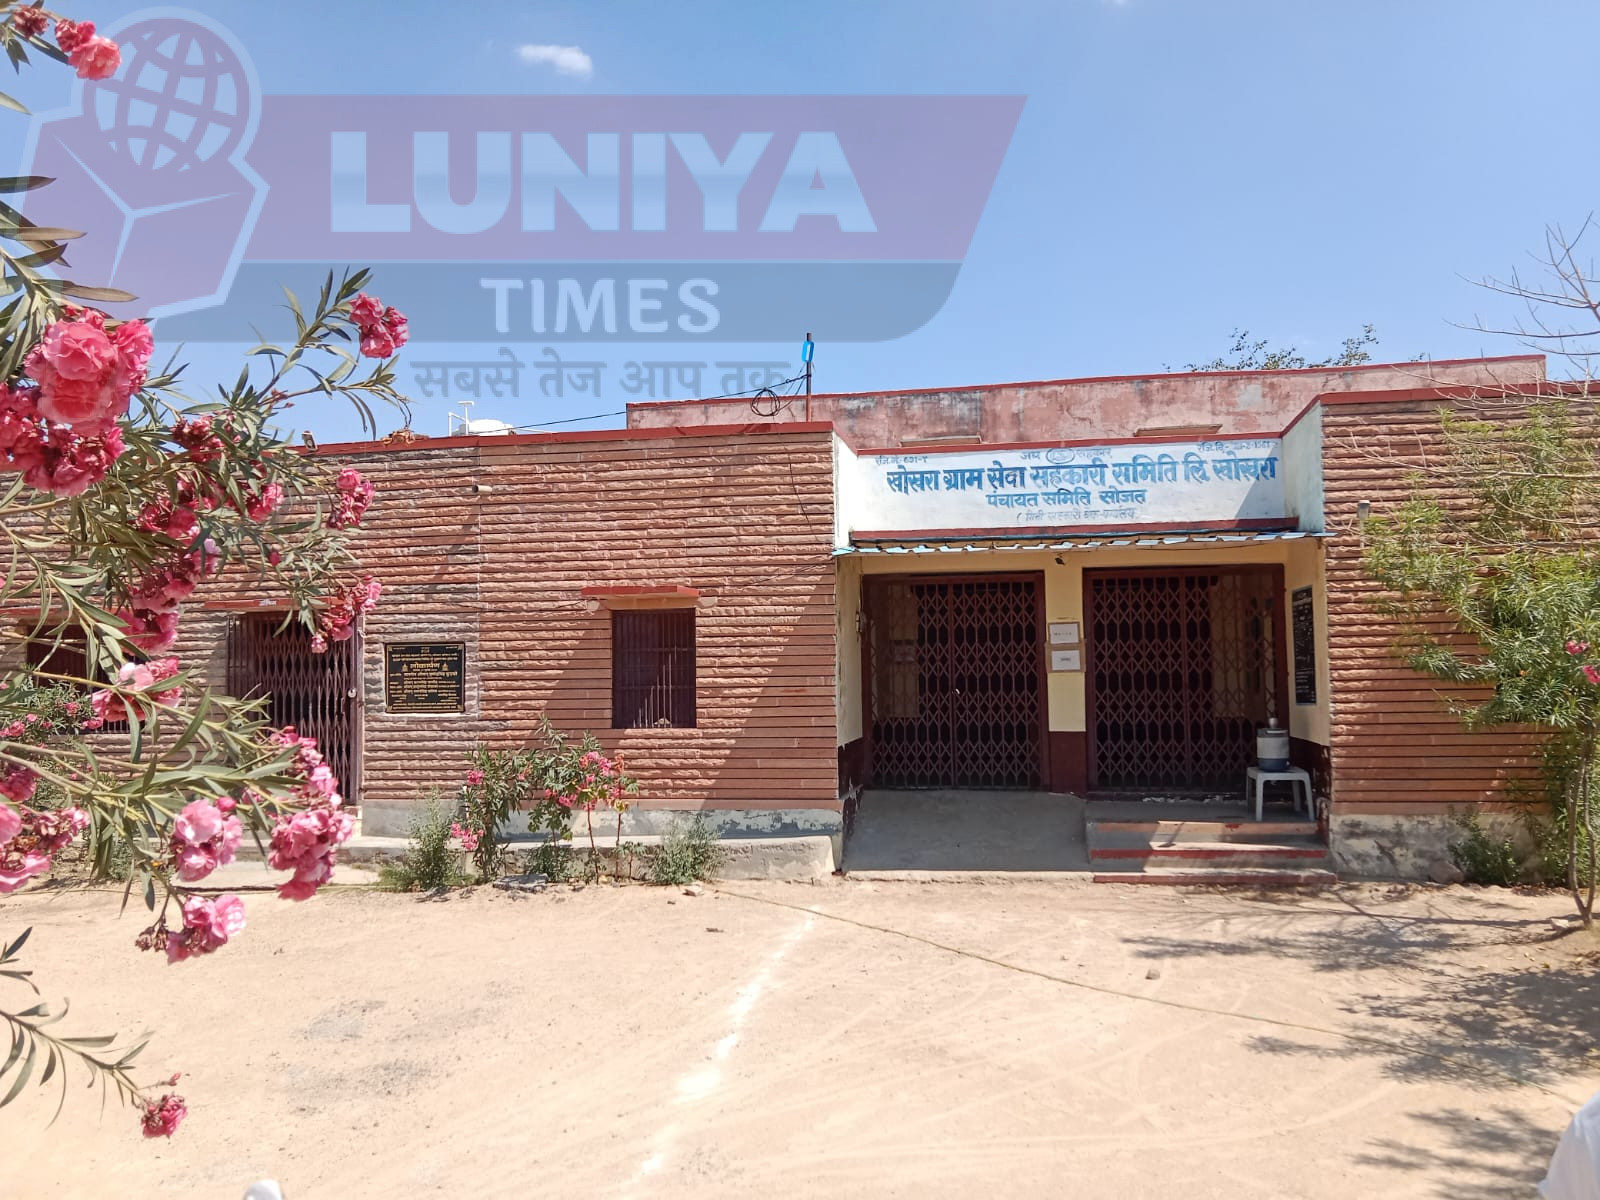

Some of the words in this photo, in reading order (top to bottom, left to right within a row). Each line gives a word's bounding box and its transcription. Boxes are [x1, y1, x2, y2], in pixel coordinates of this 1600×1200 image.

[886, 464, 940, 495] खोखरा
[943, 467, 985, 491] ग्राम
[987, 460, 1026, 490] सेवा
[1030, 457, 1108, 490] सहकारी
[1112, 453, 1179, 486] समिति
[1211, 451, 1279, 481] खोखरा
[985, 490, 1039, 508] पंचायत
[1041, 486, 1092, 506] समिति
[1098, 485, 1148, 505] सोजत
